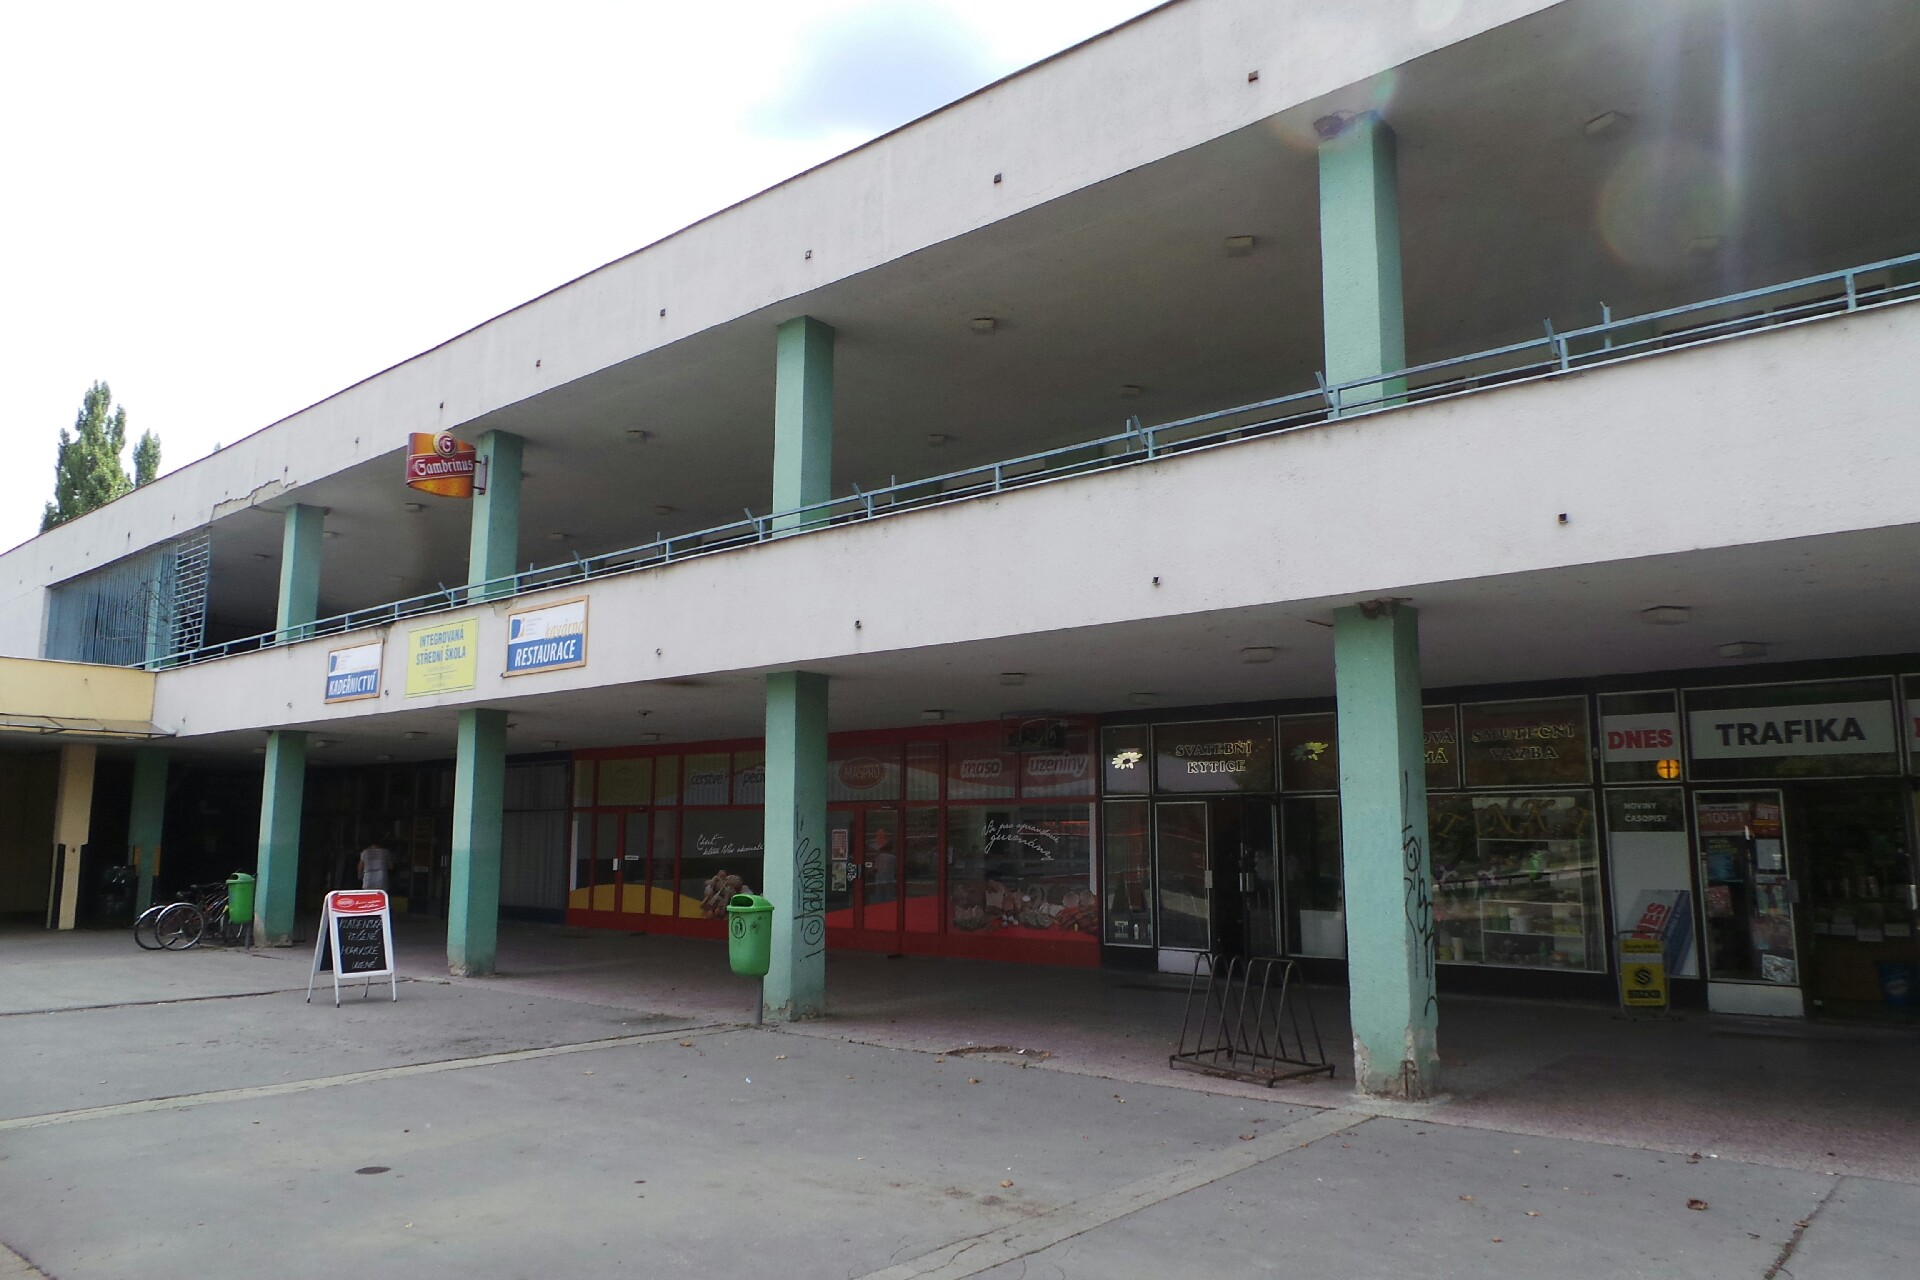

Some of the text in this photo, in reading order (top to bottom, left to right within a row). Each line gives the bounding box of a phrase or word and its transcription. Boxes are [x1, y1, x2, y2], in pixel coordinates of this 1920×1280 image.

[414, 459, 474, 477] Gambrinus
[419, 624, 464, 648] INTEGROVANÁ
[415, 644, 466, 666] STŘEDNÍ ŠKOLA
[514, 639, 576, 667] RESTAURACE
[328, 670, 378, 696] KADEŘNICTVÍ
[1607, 728, 1673, 750] DNES
[1714, 717, 1866, 747] TRAFIKA
[1175, 739, 1253, 757] SVATEBNÍ
[963, 760, 1001, 776] maso
[1187, 760, 1246, 774] KYTICE
[1624, 812, 1668, 822] ČASOPISY
